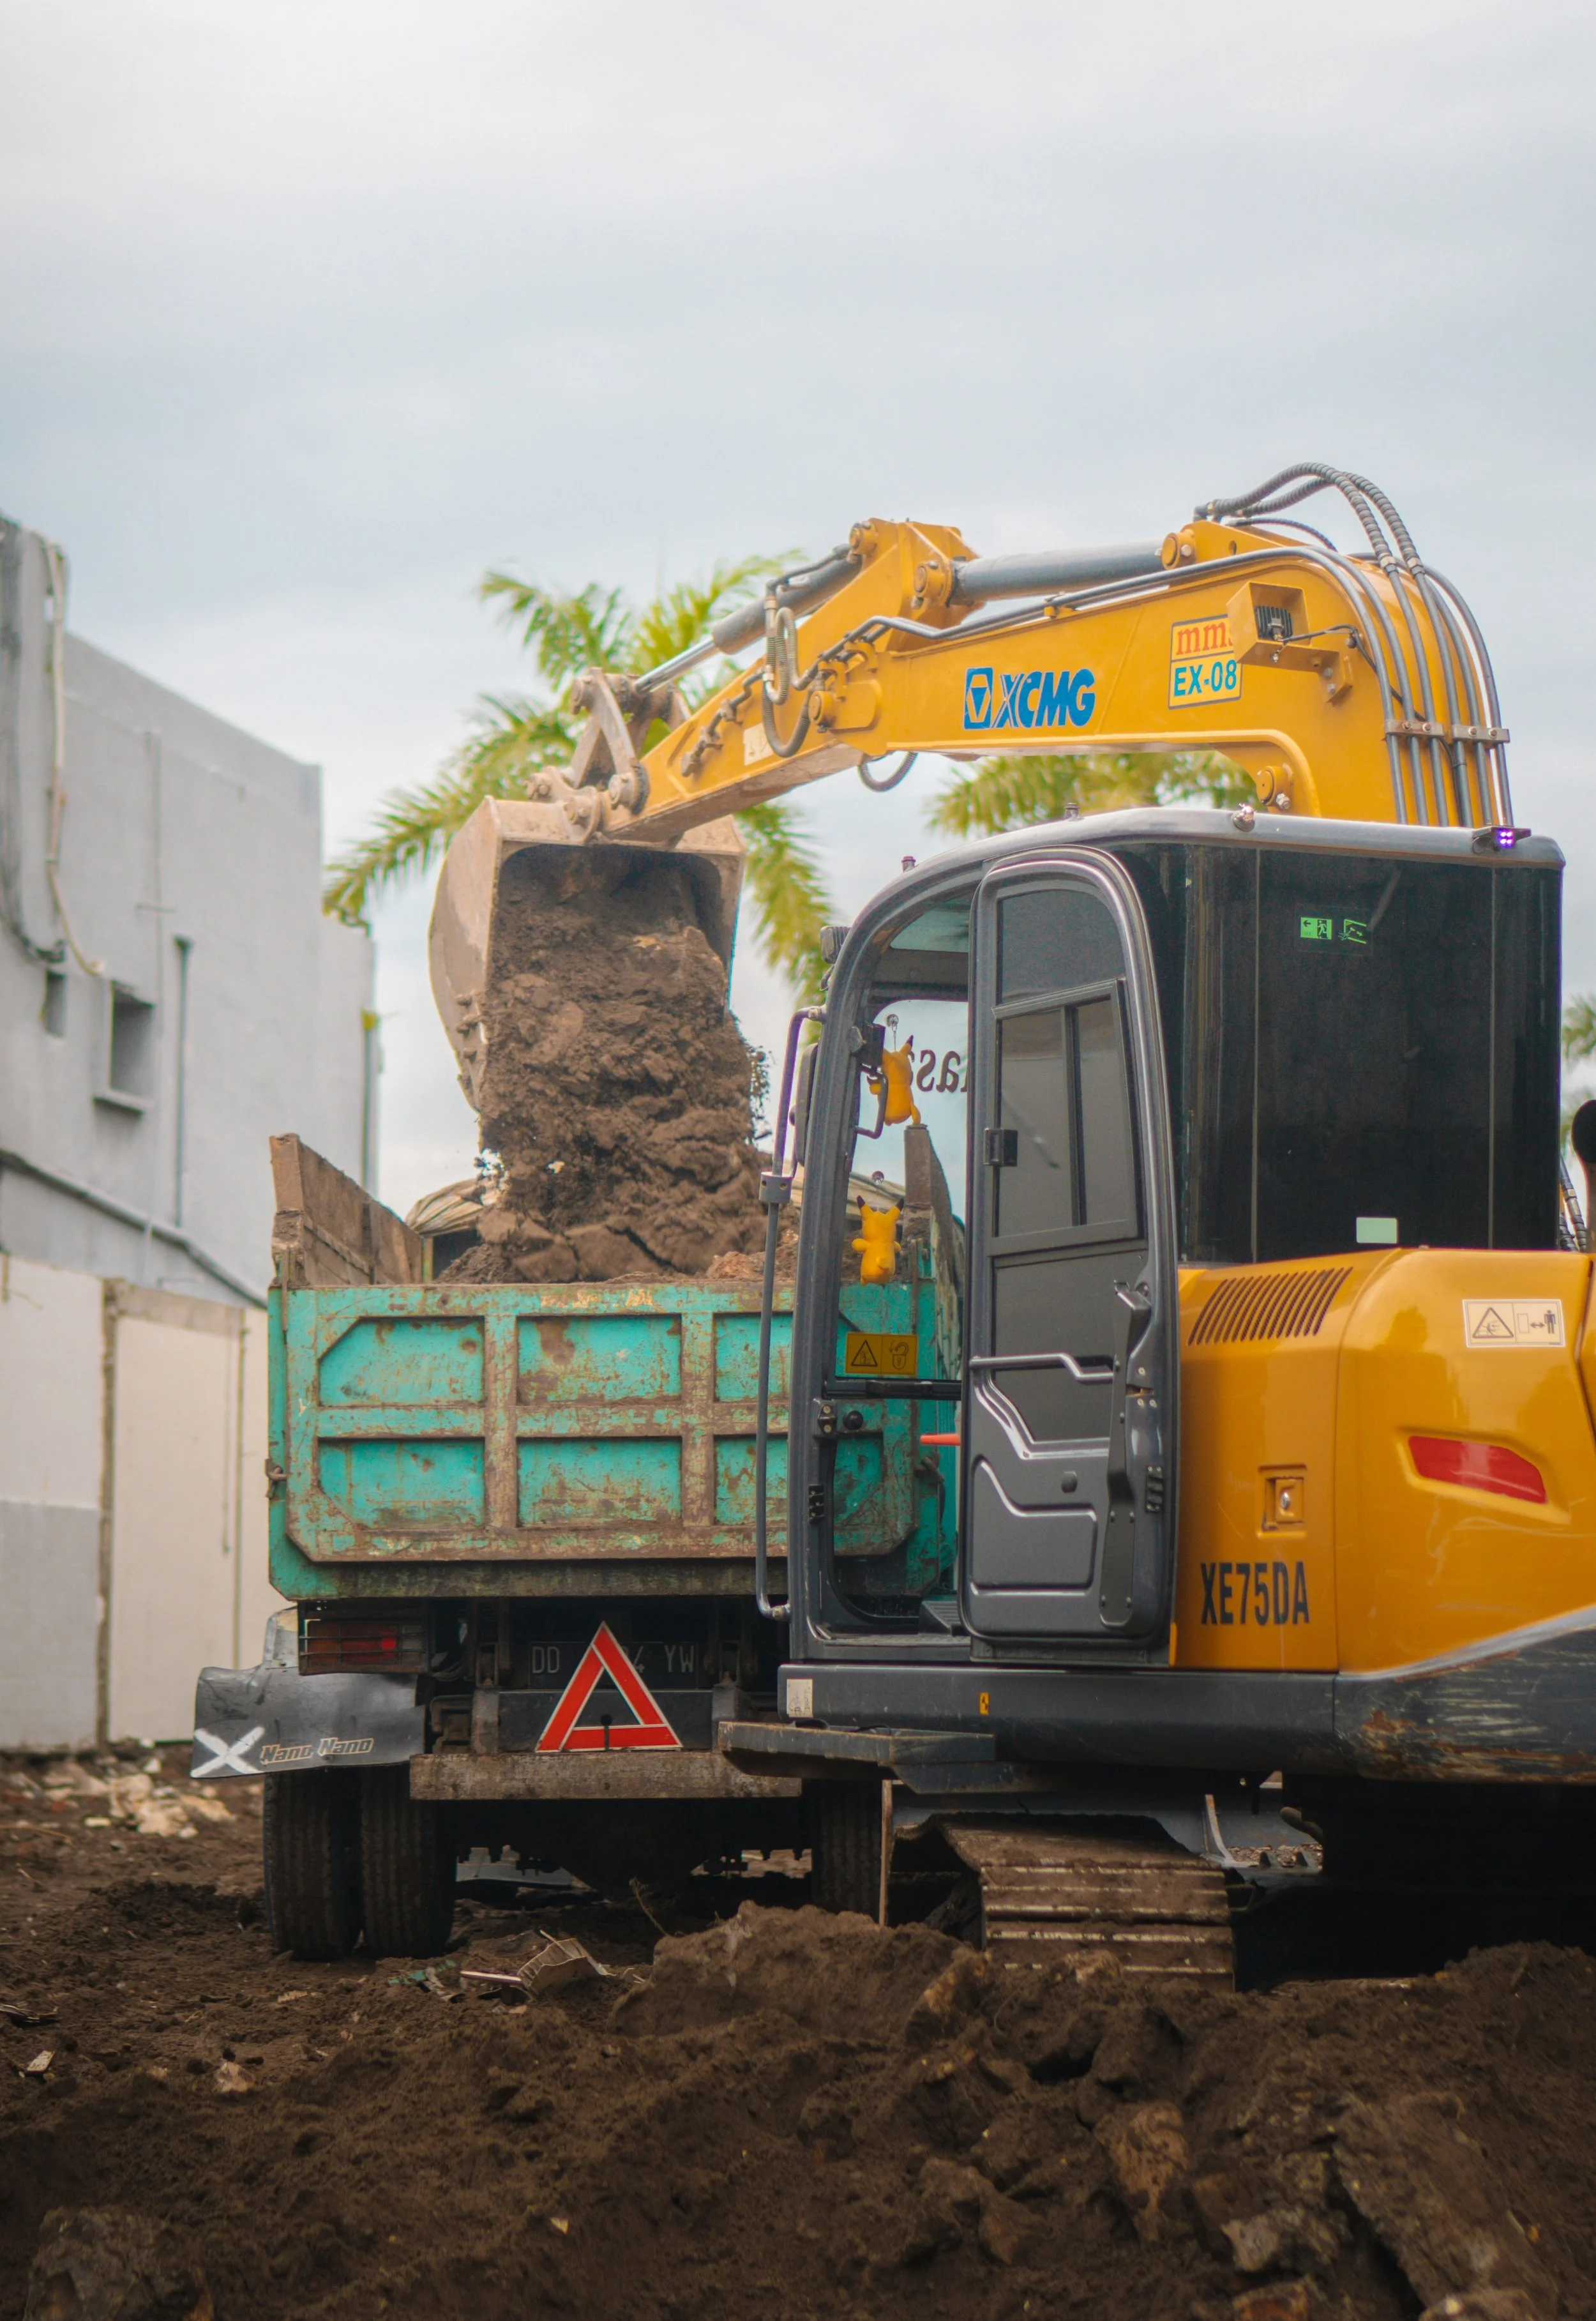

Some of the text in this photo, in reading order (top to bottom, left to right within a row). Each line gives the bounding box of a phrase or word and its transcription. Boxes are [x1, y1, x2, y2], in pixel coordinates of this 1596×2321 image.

[1176, 621, 1233, 656] mm
[1173, 659, 1237, 697] EX-08
[991, 669, 1095, 728] XCMG
[1200, 1561, 1310, 1626] XE75DA
[532, 1646, 560, 1674] DD
[665, 1645, 694, 1673] YW
[319, 1737, 374, 1757] Nano
